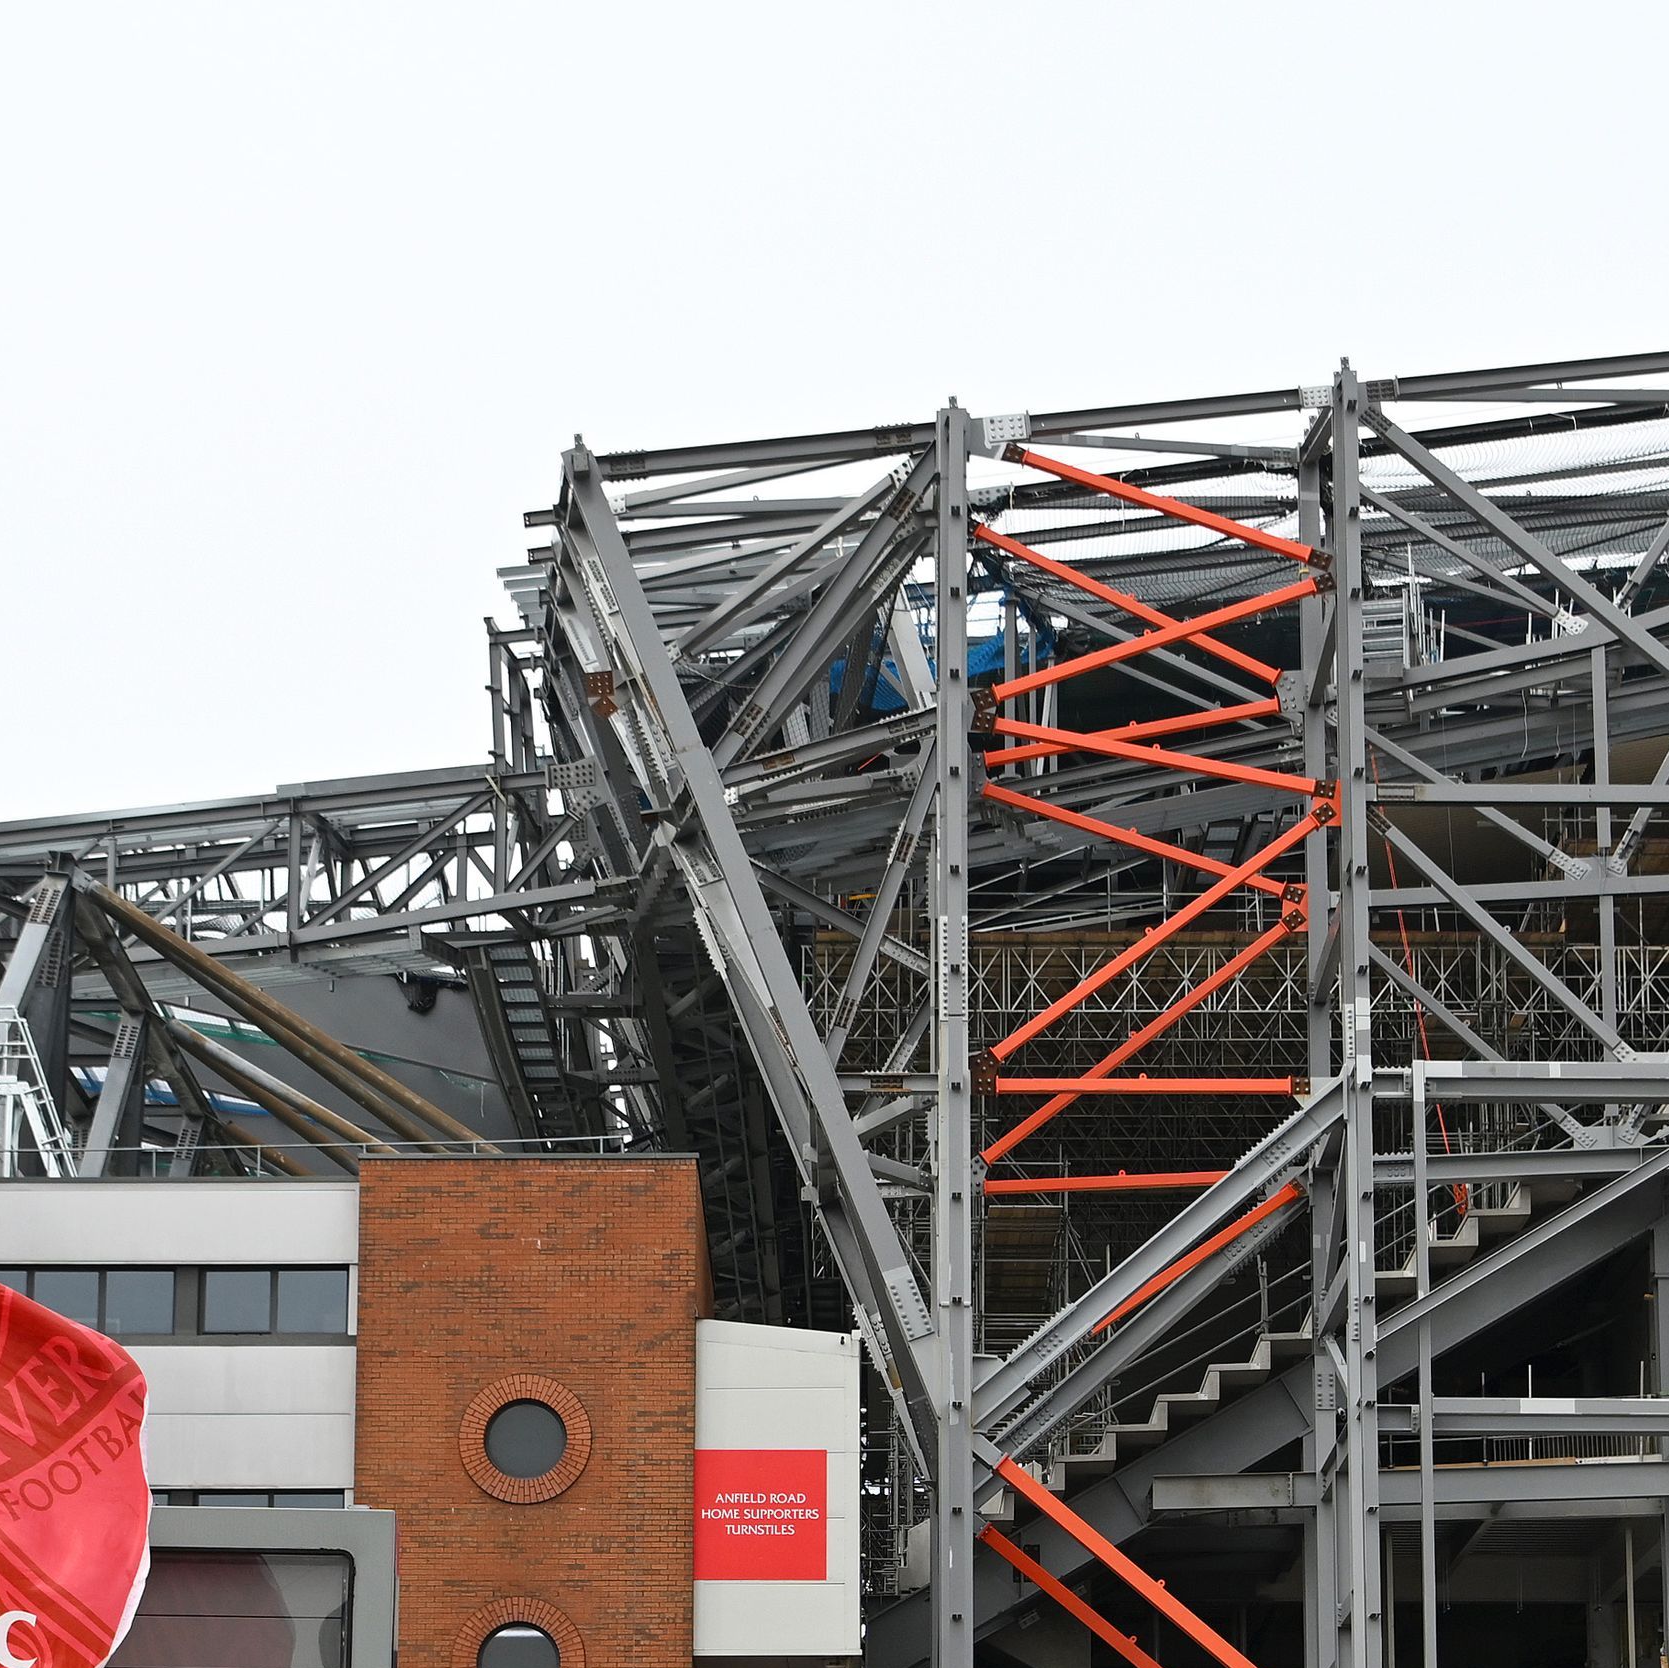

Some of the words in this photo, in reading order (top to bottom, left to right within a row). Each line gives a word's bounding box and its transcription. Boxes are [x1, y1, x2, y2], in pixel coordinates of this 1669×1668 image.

[715, 1492, 767, 1504] ANFIELD
[769, 1493, 807, 1504] ROAD
[701, 1508, 741, 1520] HOME
[743, 1508, 820, 1520] SUPPORTERS
[724, 1524, 796, 1536] TURNSTILES
